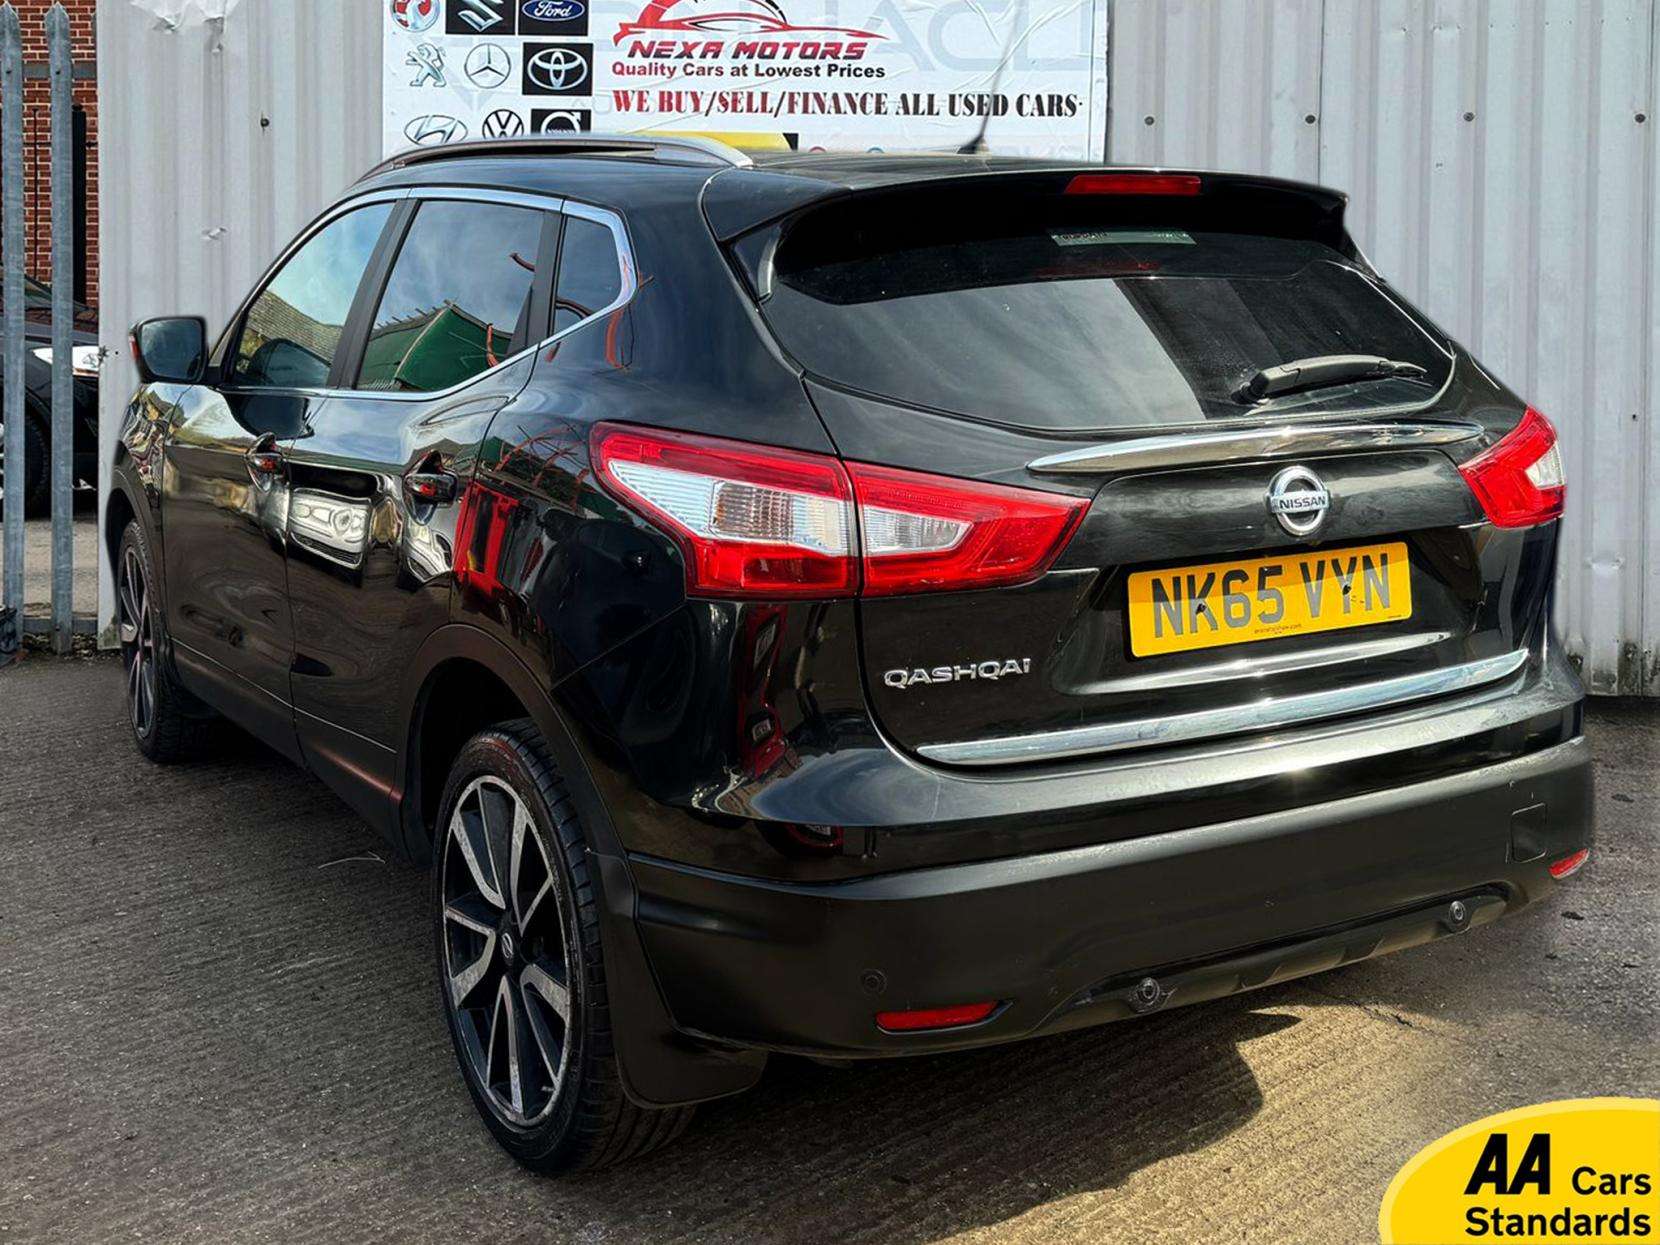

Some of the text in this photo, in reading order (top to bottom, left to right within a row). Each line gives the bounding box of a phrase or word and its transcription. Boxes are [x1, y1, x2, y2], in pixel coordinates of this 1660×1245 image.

[534, 0, 573, 17] Ford
[627, 40, 868, 60] NEXA MOTORS
[612, 61, 886, 79] Quality Cars at Lowest Prices
[612, 90, 650, 113] WE
[895, 92, 940, 116] ALL
[948, 93, 1009, 117] USED
[1279, 496, 1326, 509] NISSAN
[1150, 552, 1391, 638] NK65 VYN
[884, 658, 1031, 689] QASHQAI
